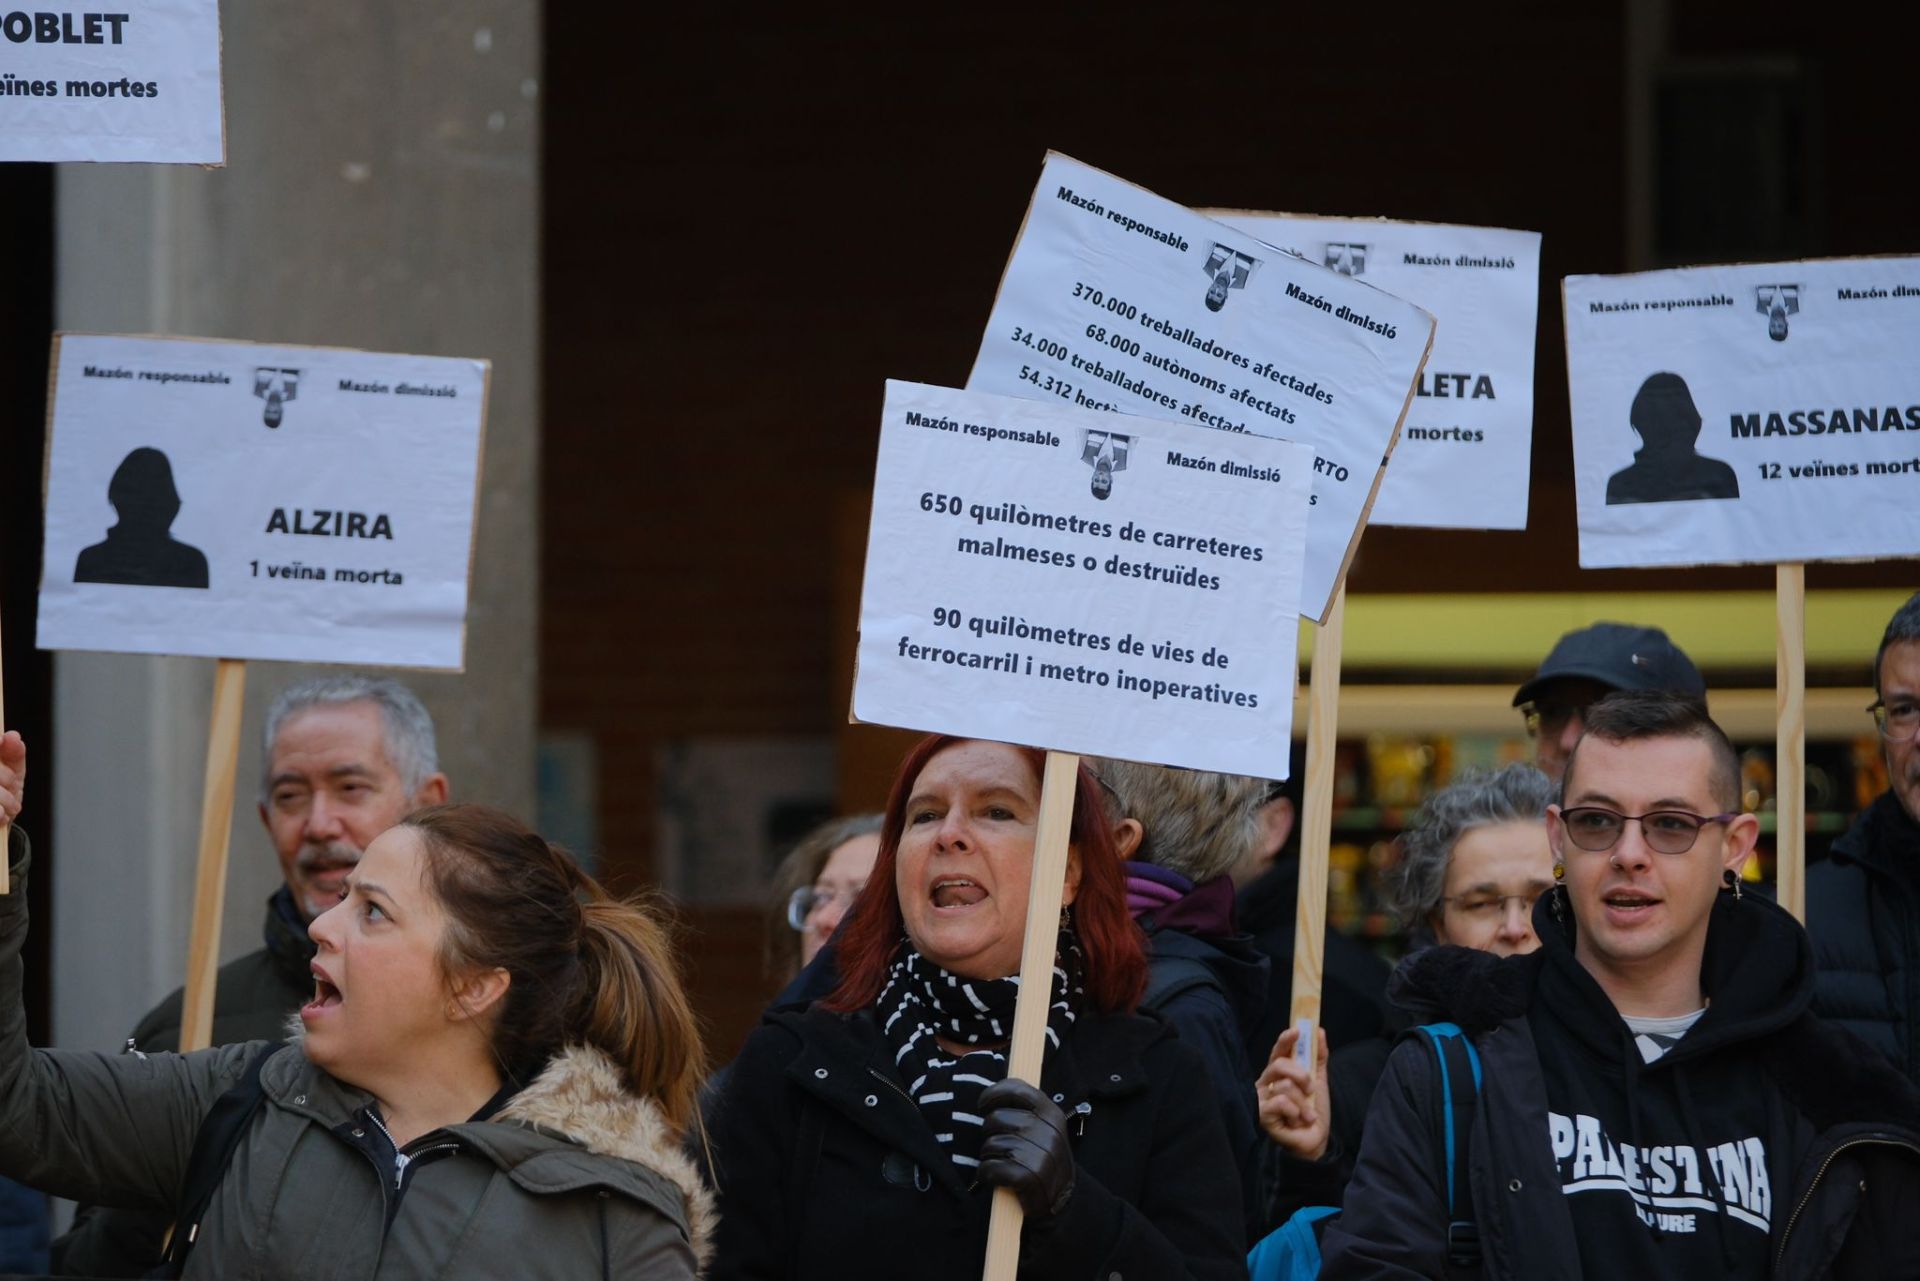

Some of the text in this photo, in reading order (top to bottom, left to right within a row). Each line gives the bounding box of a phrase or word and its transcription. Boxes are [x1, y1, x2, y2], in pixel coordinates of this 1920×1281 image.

[0, 11, 129, 44] OBLET
[0, 74, 158, 97] ïnes mortes
[1057, 187, 1188, 252] Mazón responsable
[1403, 253, 1515, 269] Mazón dimissió
[1589, 294, 1734, 313] Mazón responsable
[1837, 285, 1920, 300] Mazón dim
[1286, 283, 1396, 339] Mazón dimissió
[1073, 283, 1333, 404] 370.000 treballadores afectades
[83, 366, 231, 385] Mazón responsable
[338, 379, 457, 398] Mazón dimissió
[1012, 327, 1252, 434] 34.000 treballadores afectad
[1020, 365, 1118, 413] 54.312 hect
[1086, 325, 1295, 424] 68.000 autònoms afectats
[1416, 372, 1496, 399] LETA
[906, 412, 1059, 447] Mazón responsable
[1408, 427, 1483, 441] mortes
[1731, 406, 1920, 438] MASSANAS
[1167, 452, 1280, 482] Mazón dimissió
[1313, 456, 1349, 482] RTO
[1759, 459, 1920, 479] 12 veïnes mort
[266, 509, 392, 539] ALZIRA
[921, 493, 1262, 561] 650 quilòmetres de carreteres
[250, 560, 403, 585] 1 veïna morta
[958, 537, 1219, 590] malmeses o destruïdes
[934, 608, 1228, 668] 90 quilòmetres de vies de
[899, 637, 1257, 707] ferrocarril i metro inoperatives
